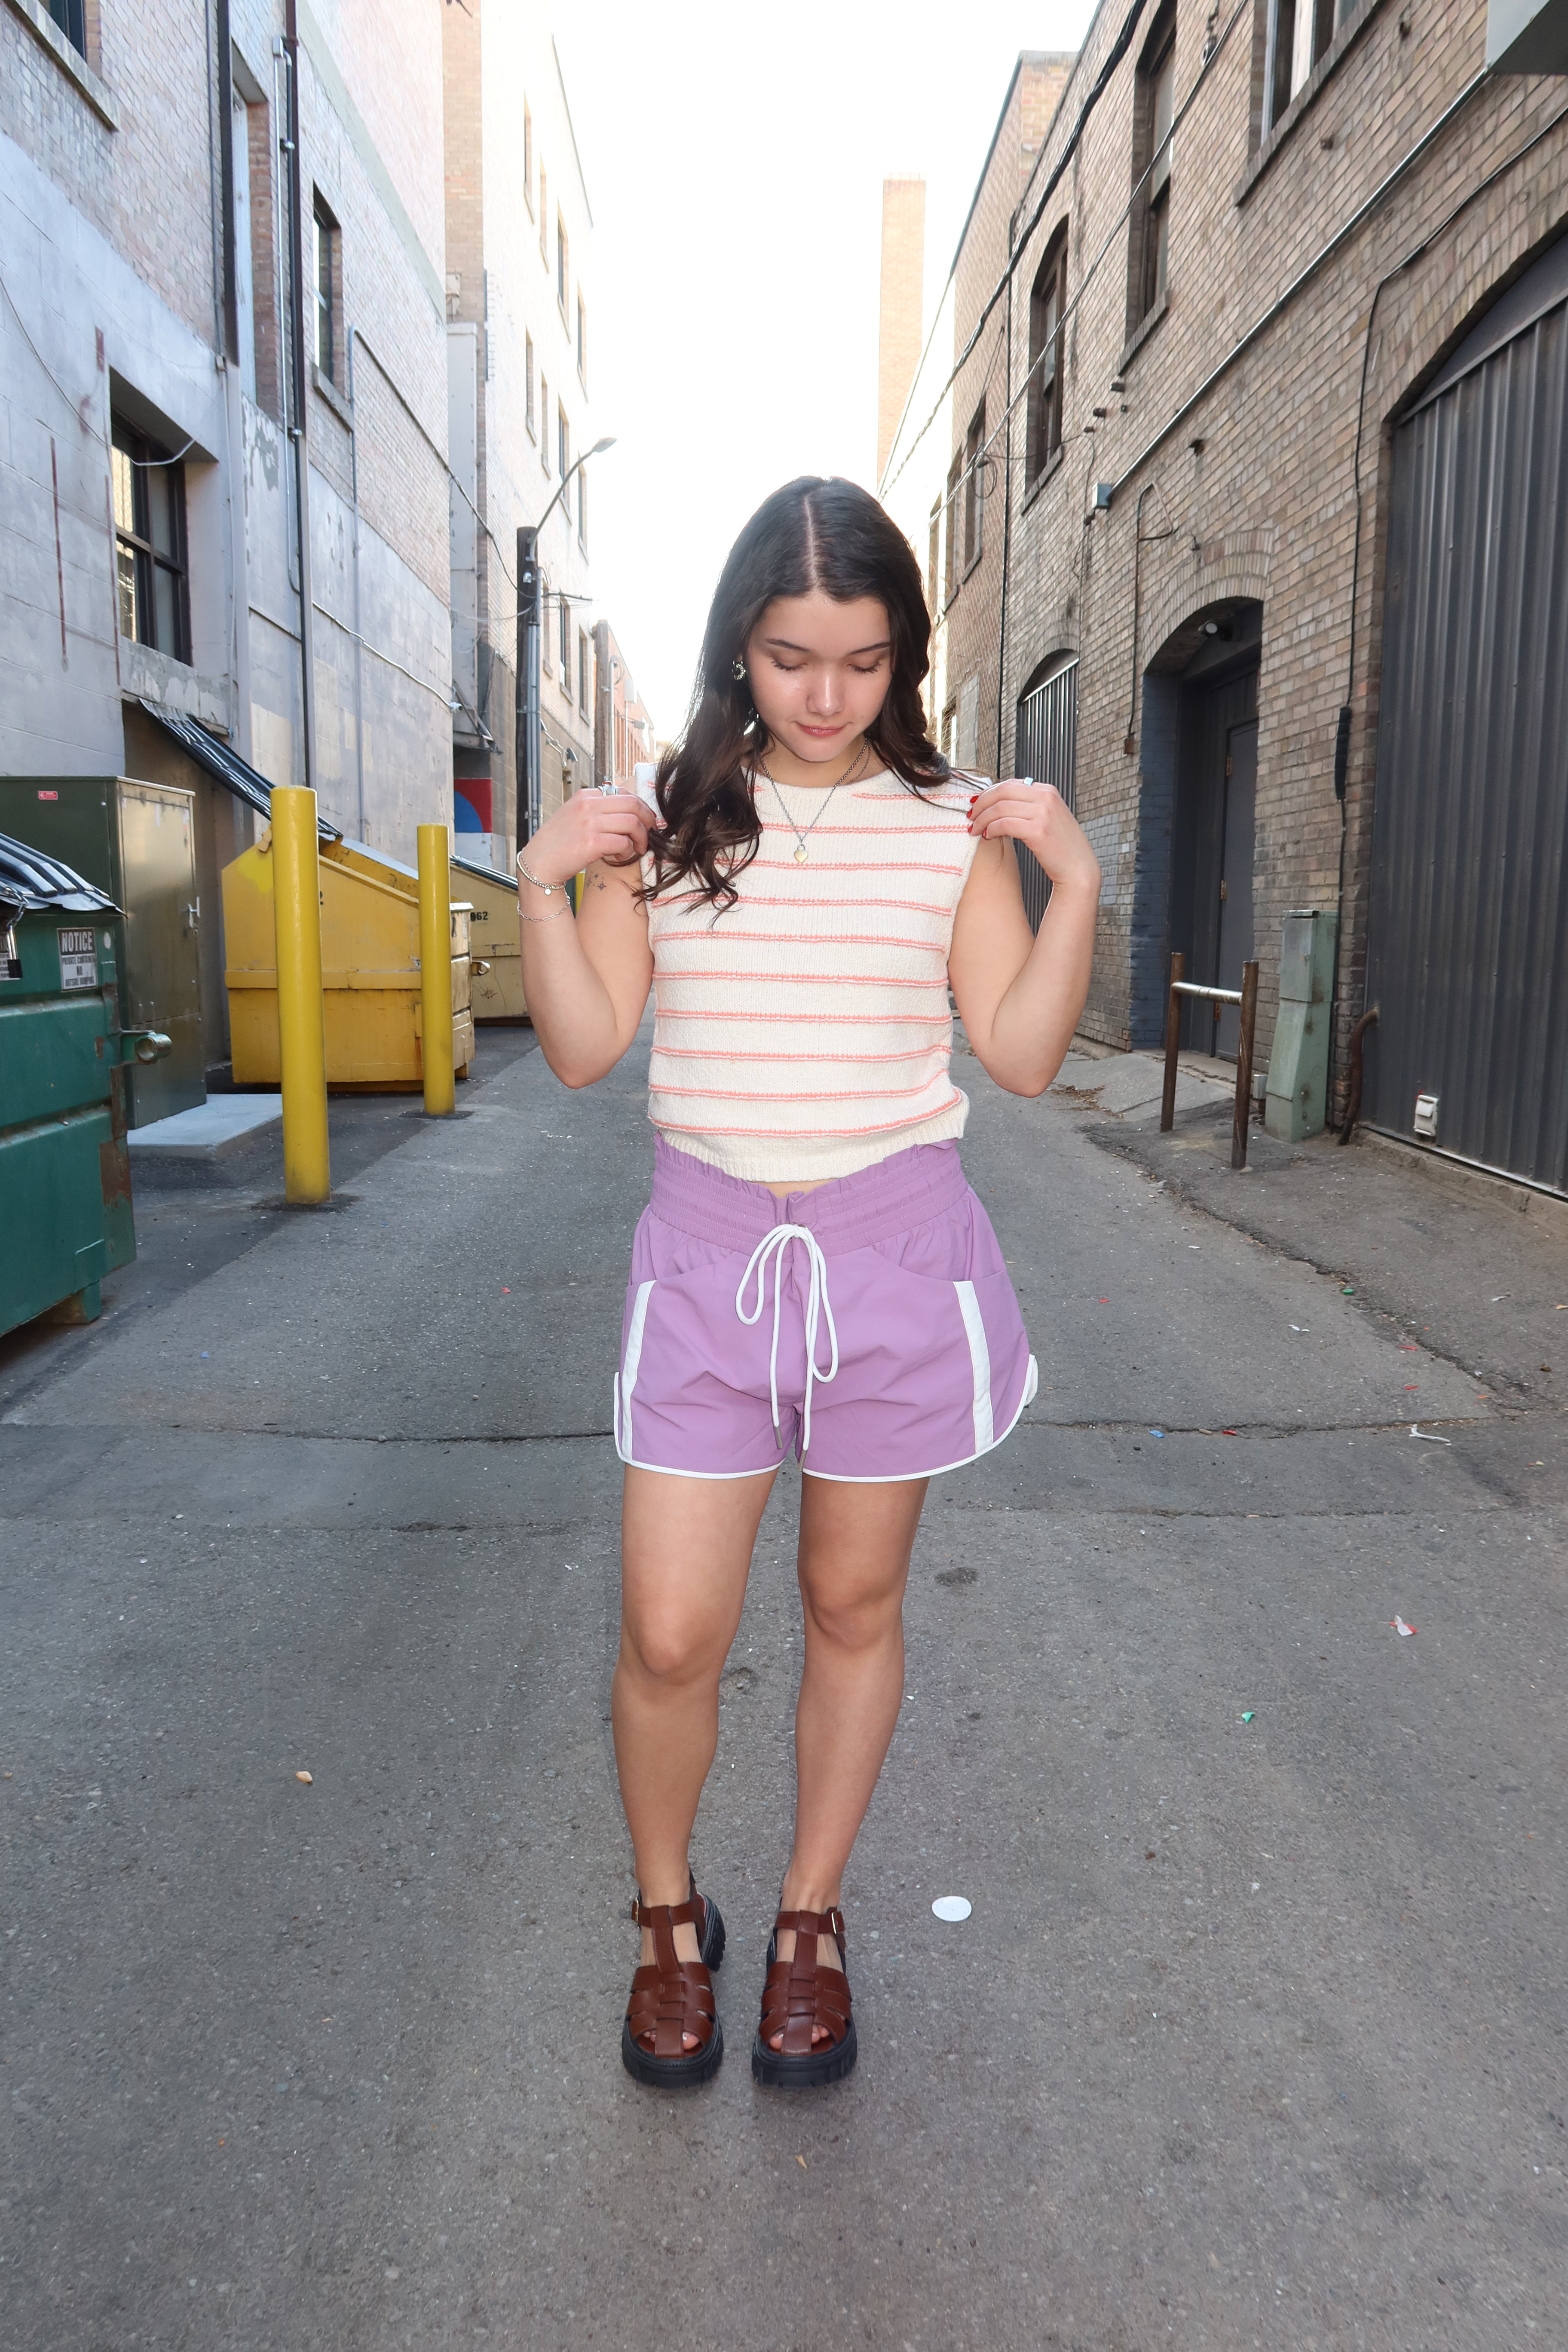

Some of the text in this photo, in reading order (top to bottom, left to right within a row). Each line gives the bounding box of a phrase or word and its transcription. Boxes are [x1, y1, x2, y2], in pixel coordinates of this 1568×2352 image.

[61, 931, 93, 952] NOTICE
[77, 965, 83, 976] NO
[65, 976, 95, 987] OUTSIDE DUMPING
